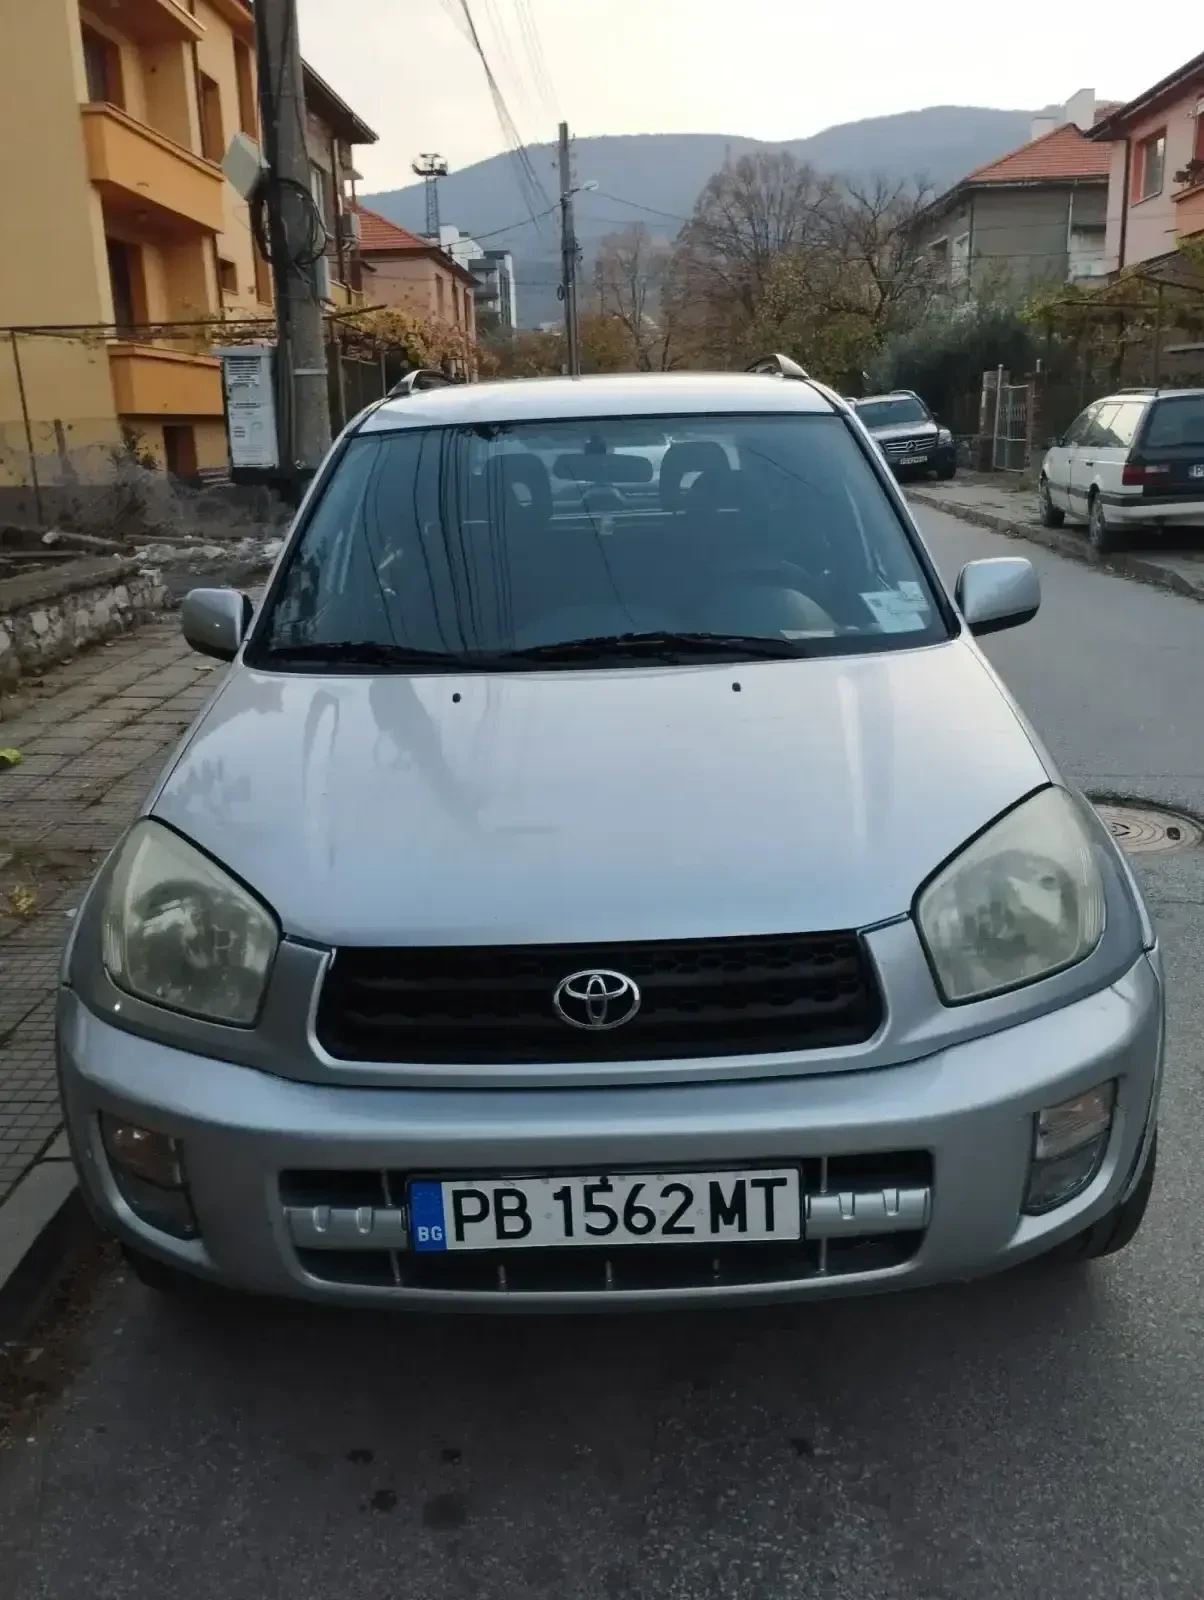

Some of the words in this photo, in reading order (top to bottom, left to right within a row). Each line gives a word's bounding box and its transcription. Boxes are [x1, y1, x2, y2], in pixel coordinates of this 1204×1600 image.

[452, 1188, 532, 1242] PB
[553, 1182, 696, 1237] 1562
[709, 1177, 788, 1235] MT
[418, 1226, 443, 1242] BG
